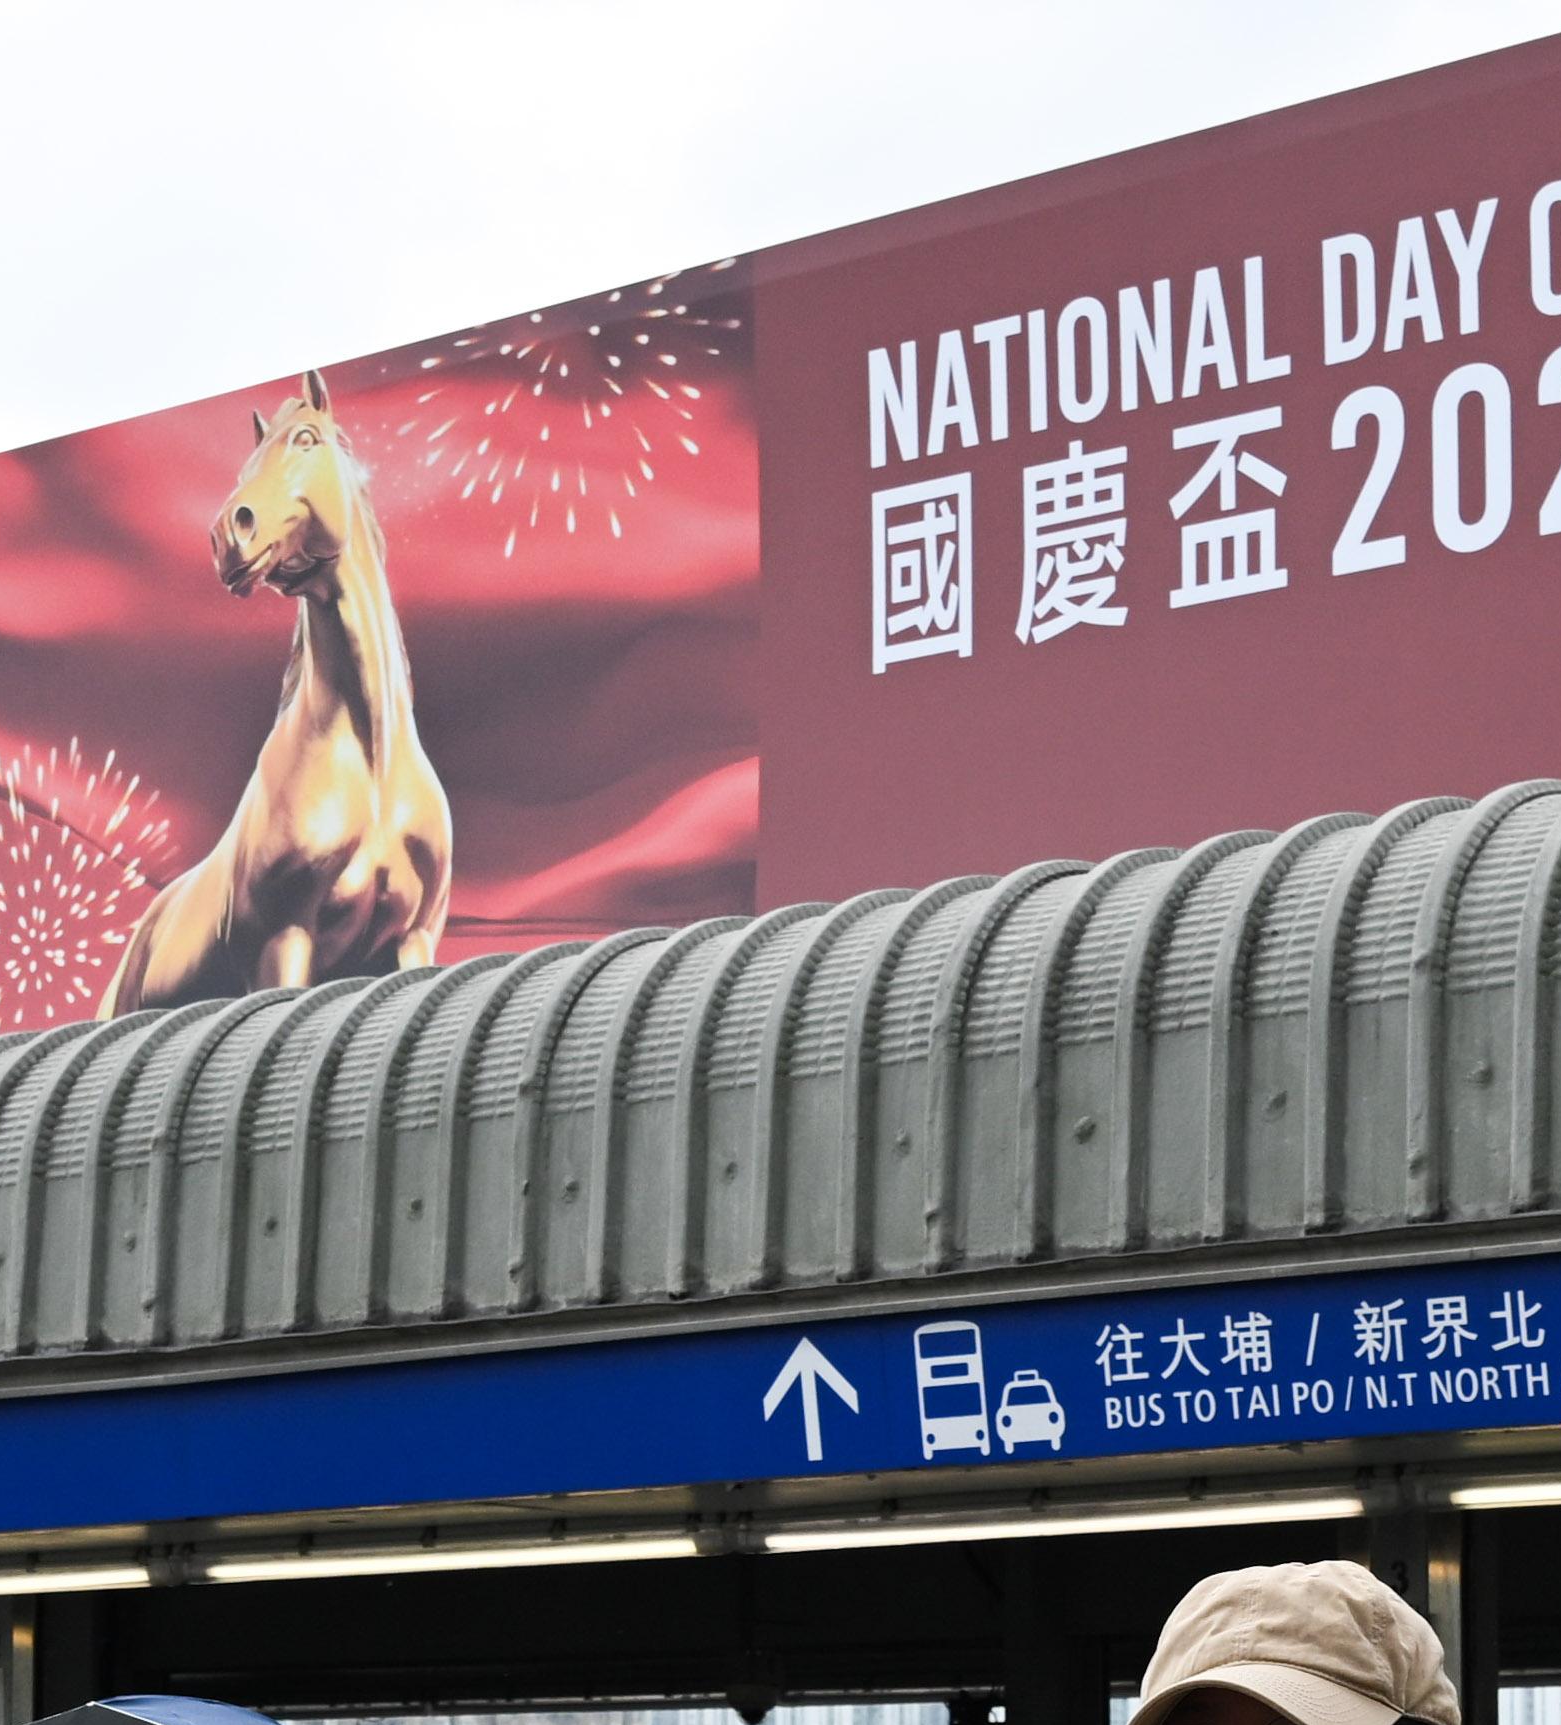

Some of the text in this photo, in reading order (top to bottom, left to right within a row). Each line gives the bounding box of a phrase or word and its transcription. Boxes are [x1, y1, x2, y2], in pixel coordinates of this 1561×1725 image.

[868, 256, 1291, 468] NATIONAL
[1322, 198, 1499, 365] DAY
[870, 406, 1288, 675] 國慶盃
[1095, 1311, 1273, 1387] 往大埔
[1353, 1289, 1545, 1366] 新界北
[1104, 1393, 1165, 1430] BUS
[1172, 1390, 1216, 1425] TO
[1224, 1383, 1281, 1420] TAI
[1293, 1379, 1334, 1415] PO
[1364, 1372, 1416, 1410] N.T
[1429, 1363, 1549, 1405] NORTH
